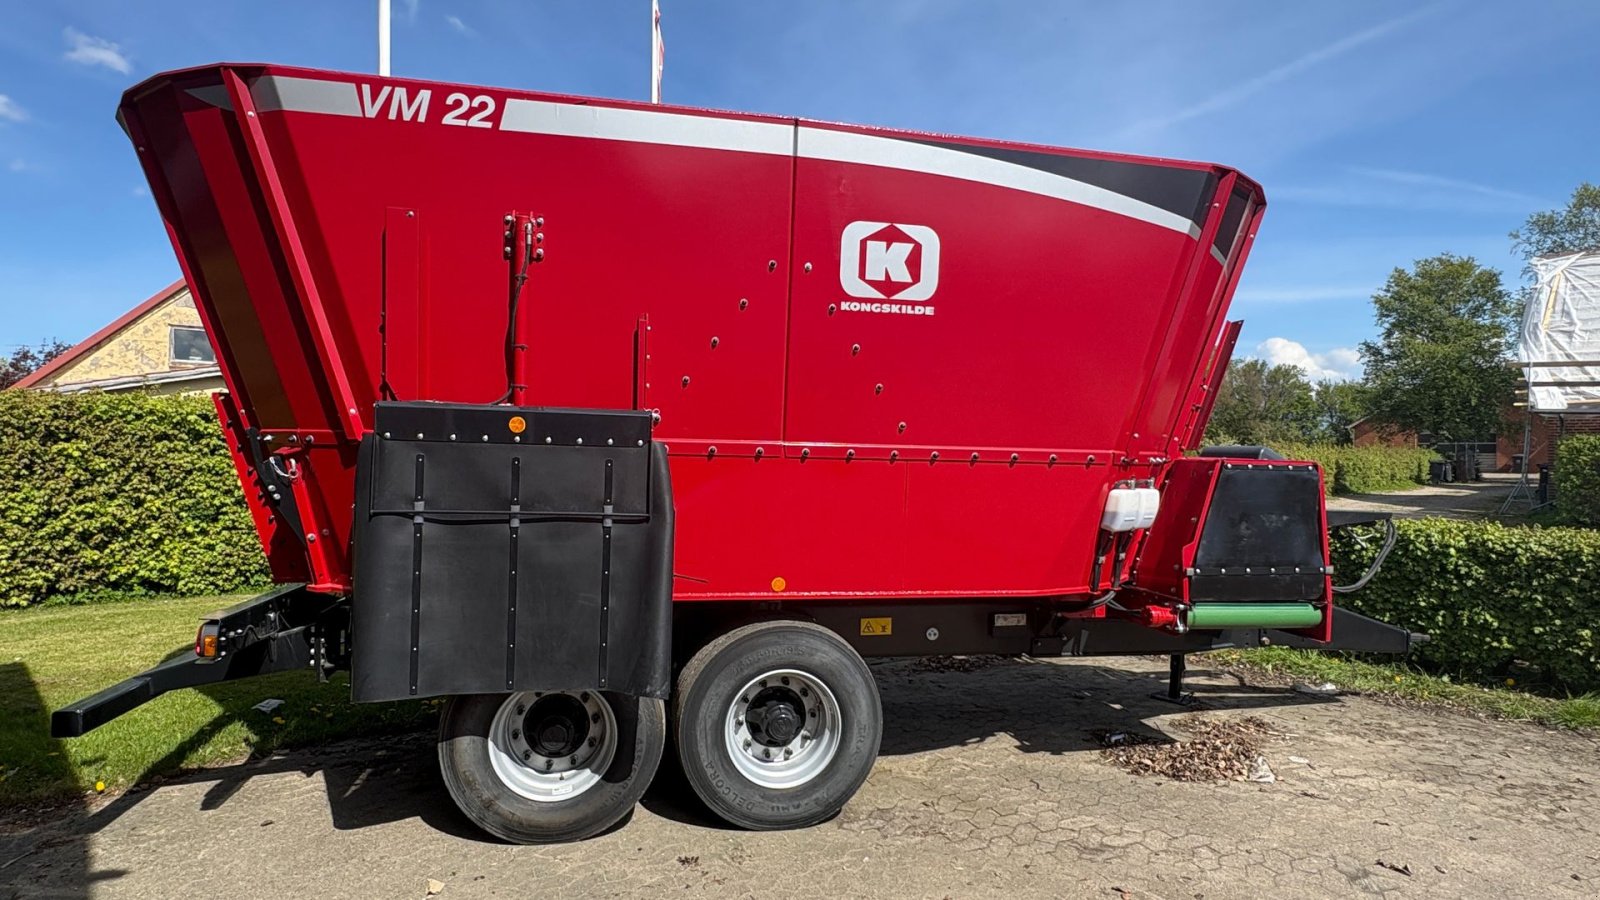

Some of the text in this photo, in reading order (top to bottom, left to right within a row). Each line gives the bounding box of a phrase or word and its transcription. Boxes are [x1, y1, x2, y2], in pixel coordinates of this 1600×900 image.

[361, 83, 496, 129] VM 22
[865, 240, 915, 283] K
[840, 301, 935, 316] KONGSKILDE
[705, 760, 756, 811] DELCORA
